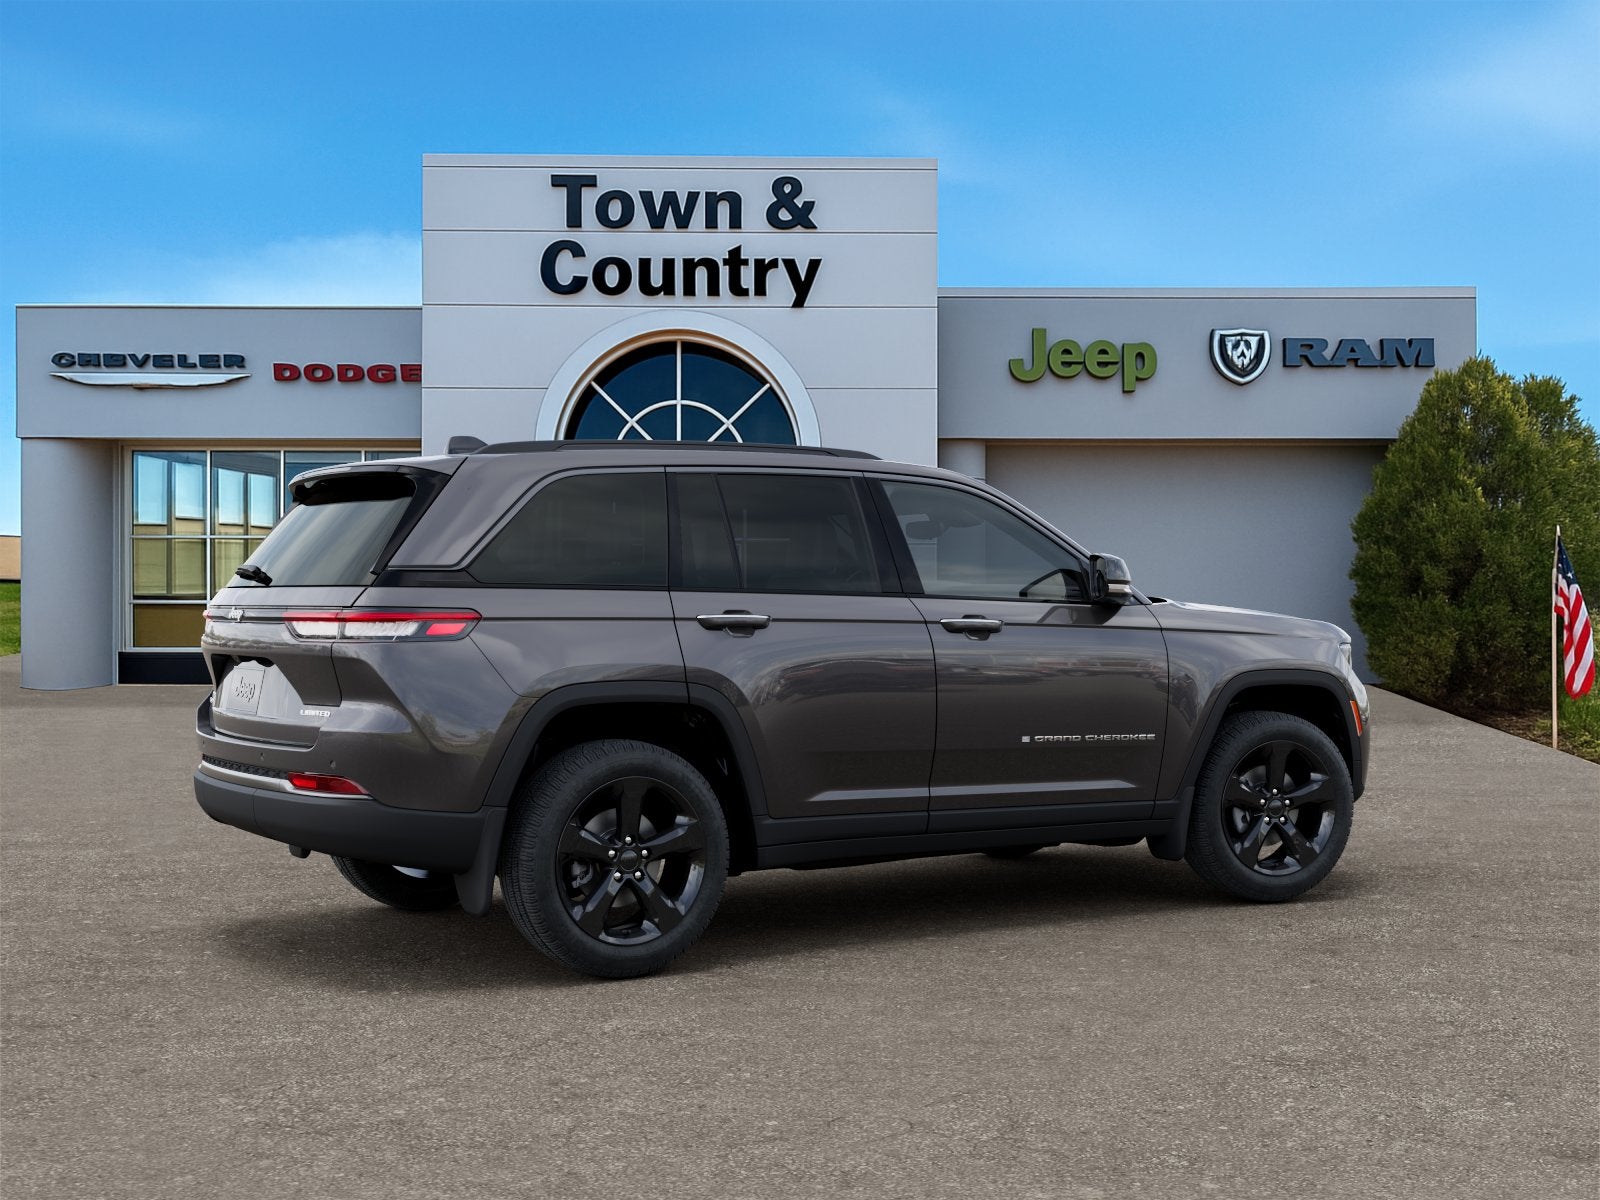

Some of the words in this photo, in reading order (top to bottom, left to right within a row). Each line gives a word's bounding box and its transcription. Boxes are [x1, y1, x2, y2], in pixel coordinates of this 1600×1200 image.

[550, 174, 743, 230] Town
[765, 176, 818, 231] &
[540, 239, 823, 308] Country
[1008, 328, 1158, 393] Jeep
[1282, 337, 1435, 368] RAM
[273, 362, 422, 384] DODGE
[299, 708, 331, 719] LIMITED
[1033, 734, 1082, 743] GRAND
[1084, 732, 1156, 742] CHEROKEE
